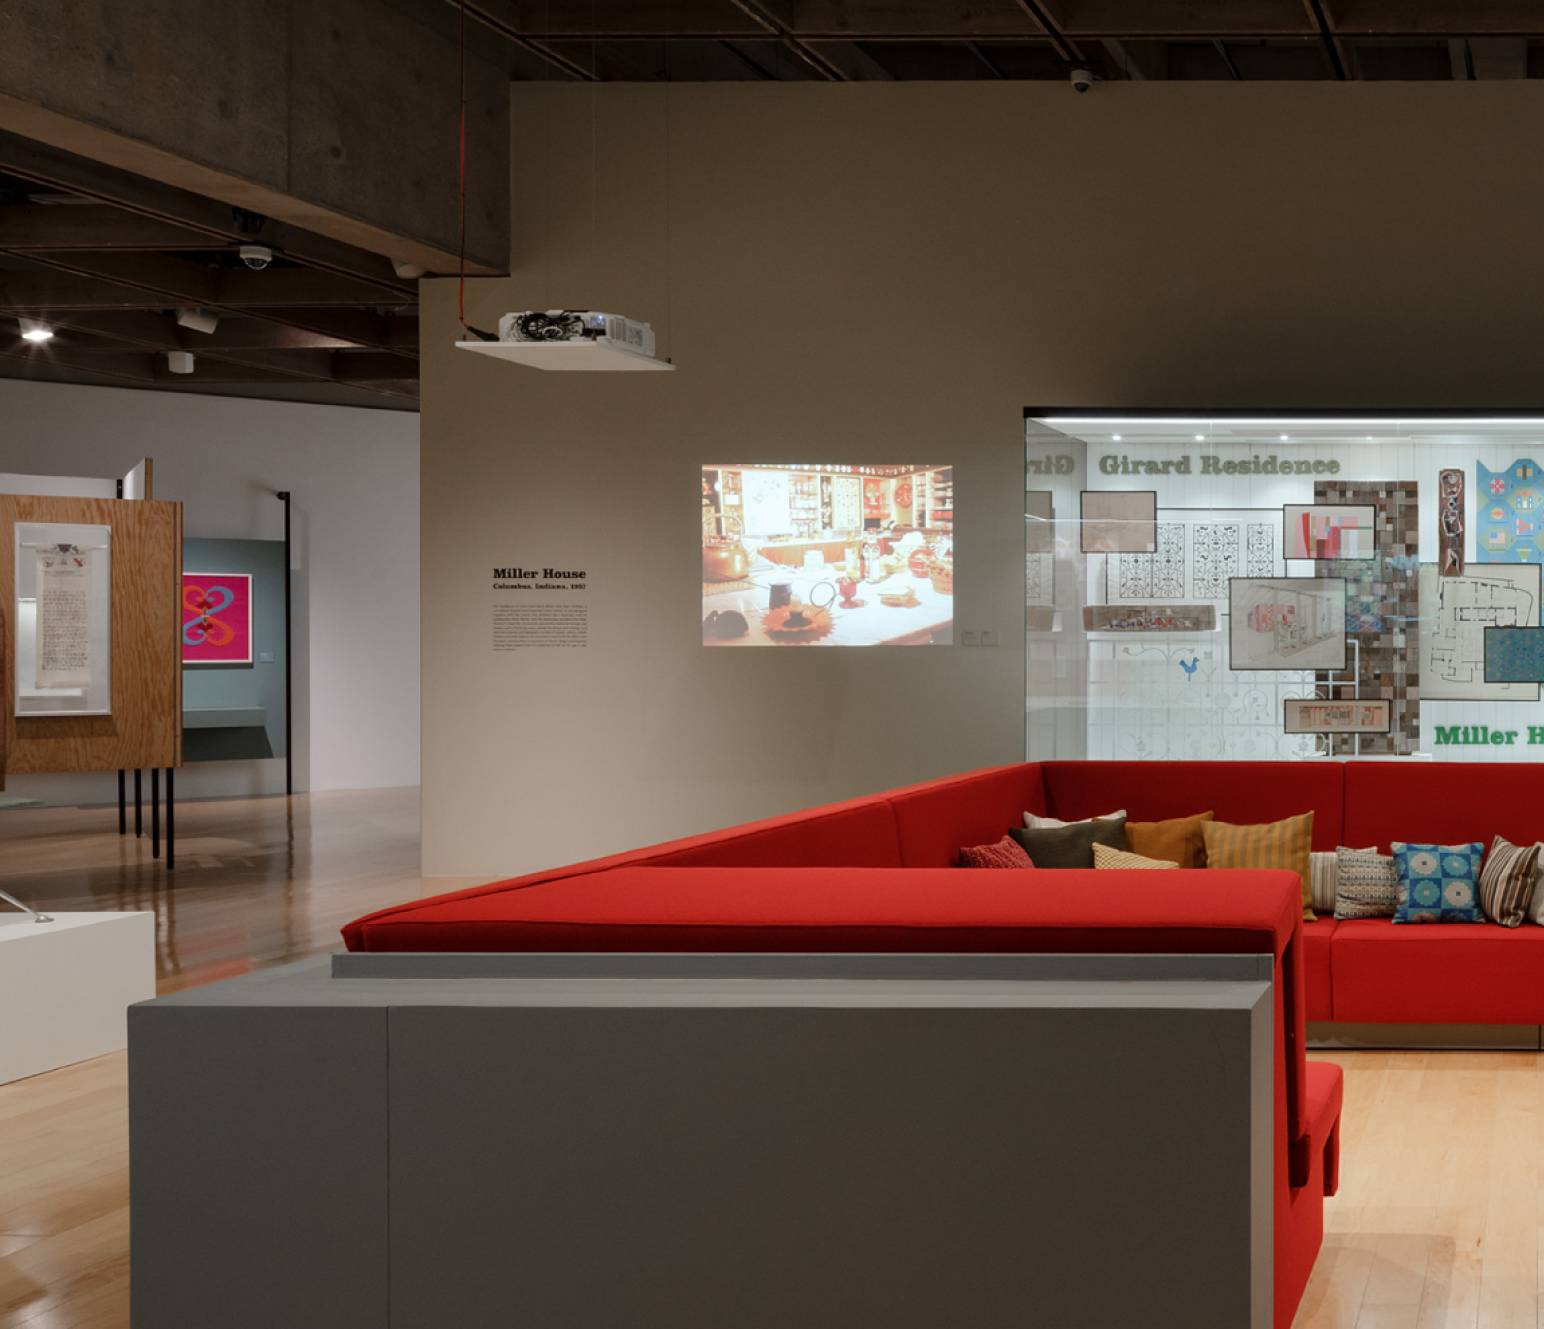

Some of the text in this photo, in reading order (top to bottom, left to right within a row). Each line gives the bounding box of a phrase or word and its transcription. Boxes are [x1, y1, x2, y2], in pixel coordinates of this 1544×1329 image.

[1099, 455, 1341, 475] Girard Residence
[493, 568, 587, 579] Miller House
[1434, 726, 1518, 745] Miller
